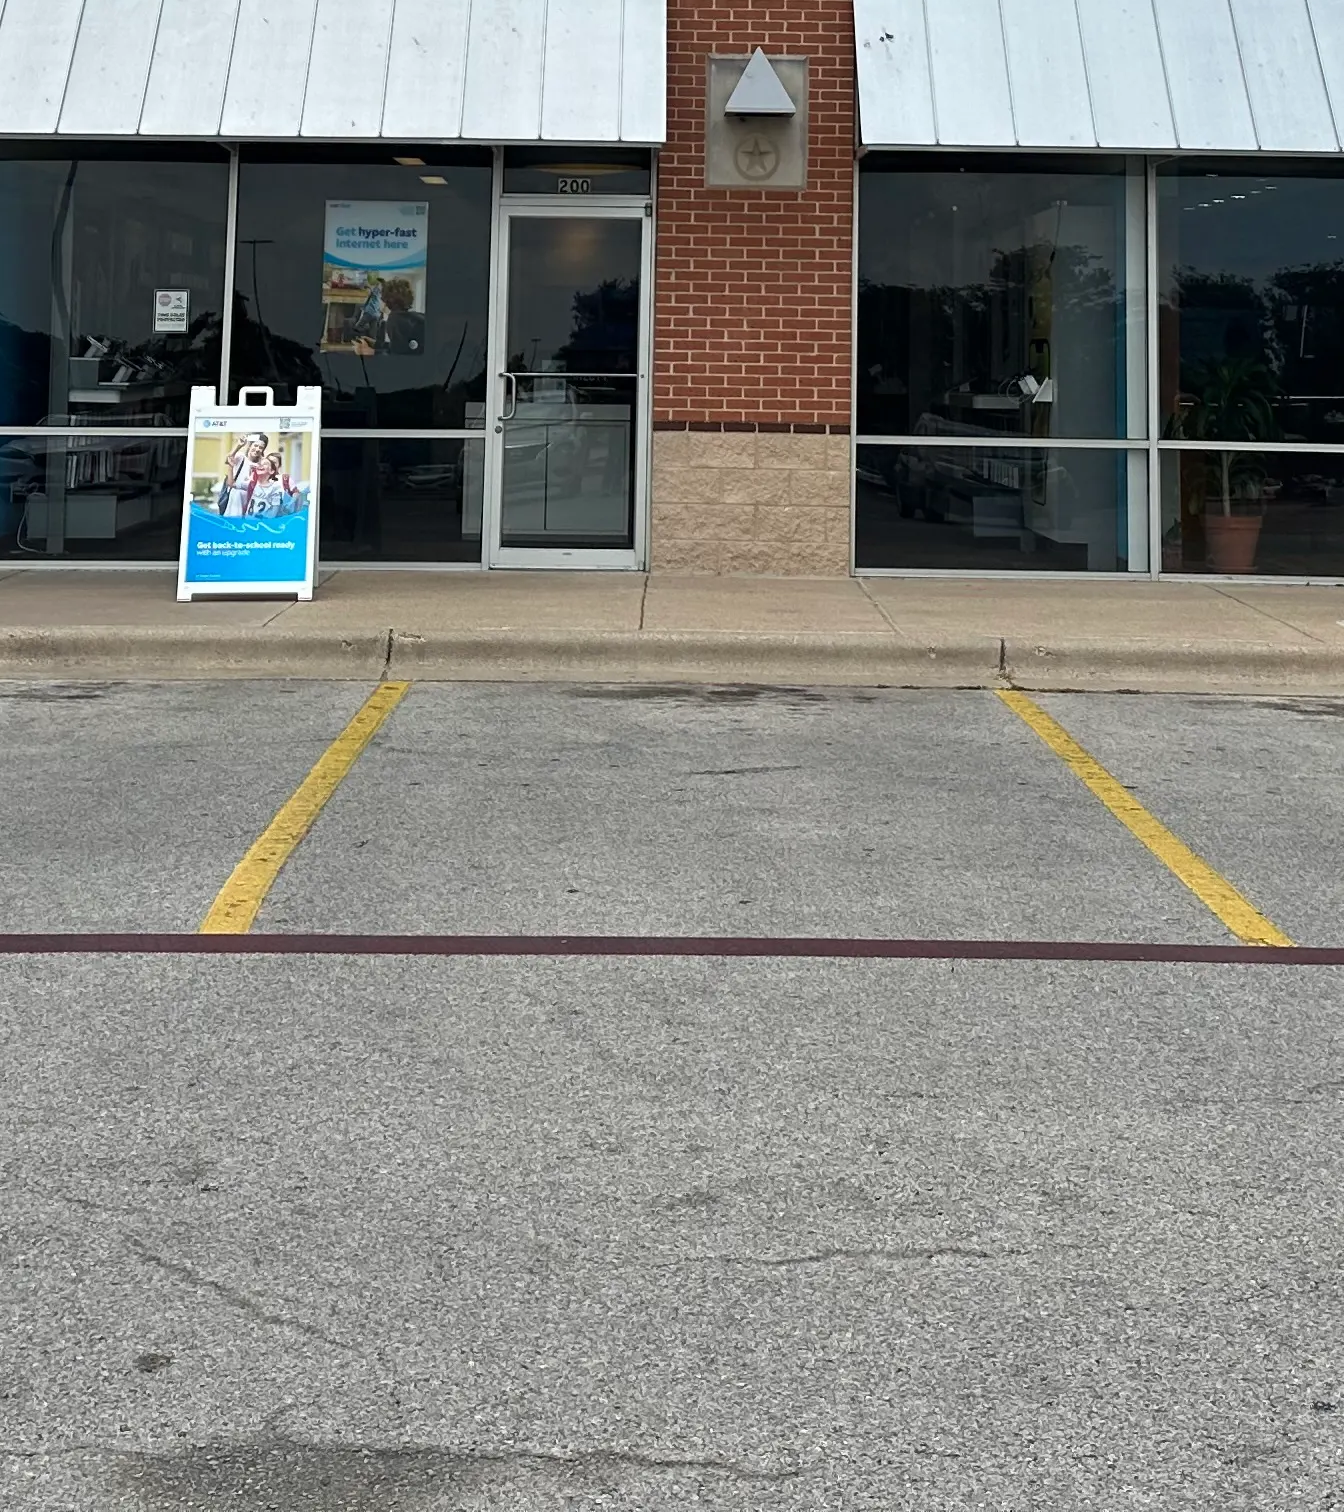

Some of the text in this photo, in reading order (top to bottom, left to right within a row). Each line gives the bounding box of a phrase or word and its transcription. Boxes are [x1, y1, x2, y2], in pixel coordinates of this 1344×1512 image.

[559, 179, 590, 193] 200
[336, 227, 417, 239] Get hyper-fast
[336, 239, 408, 249] Internet here
